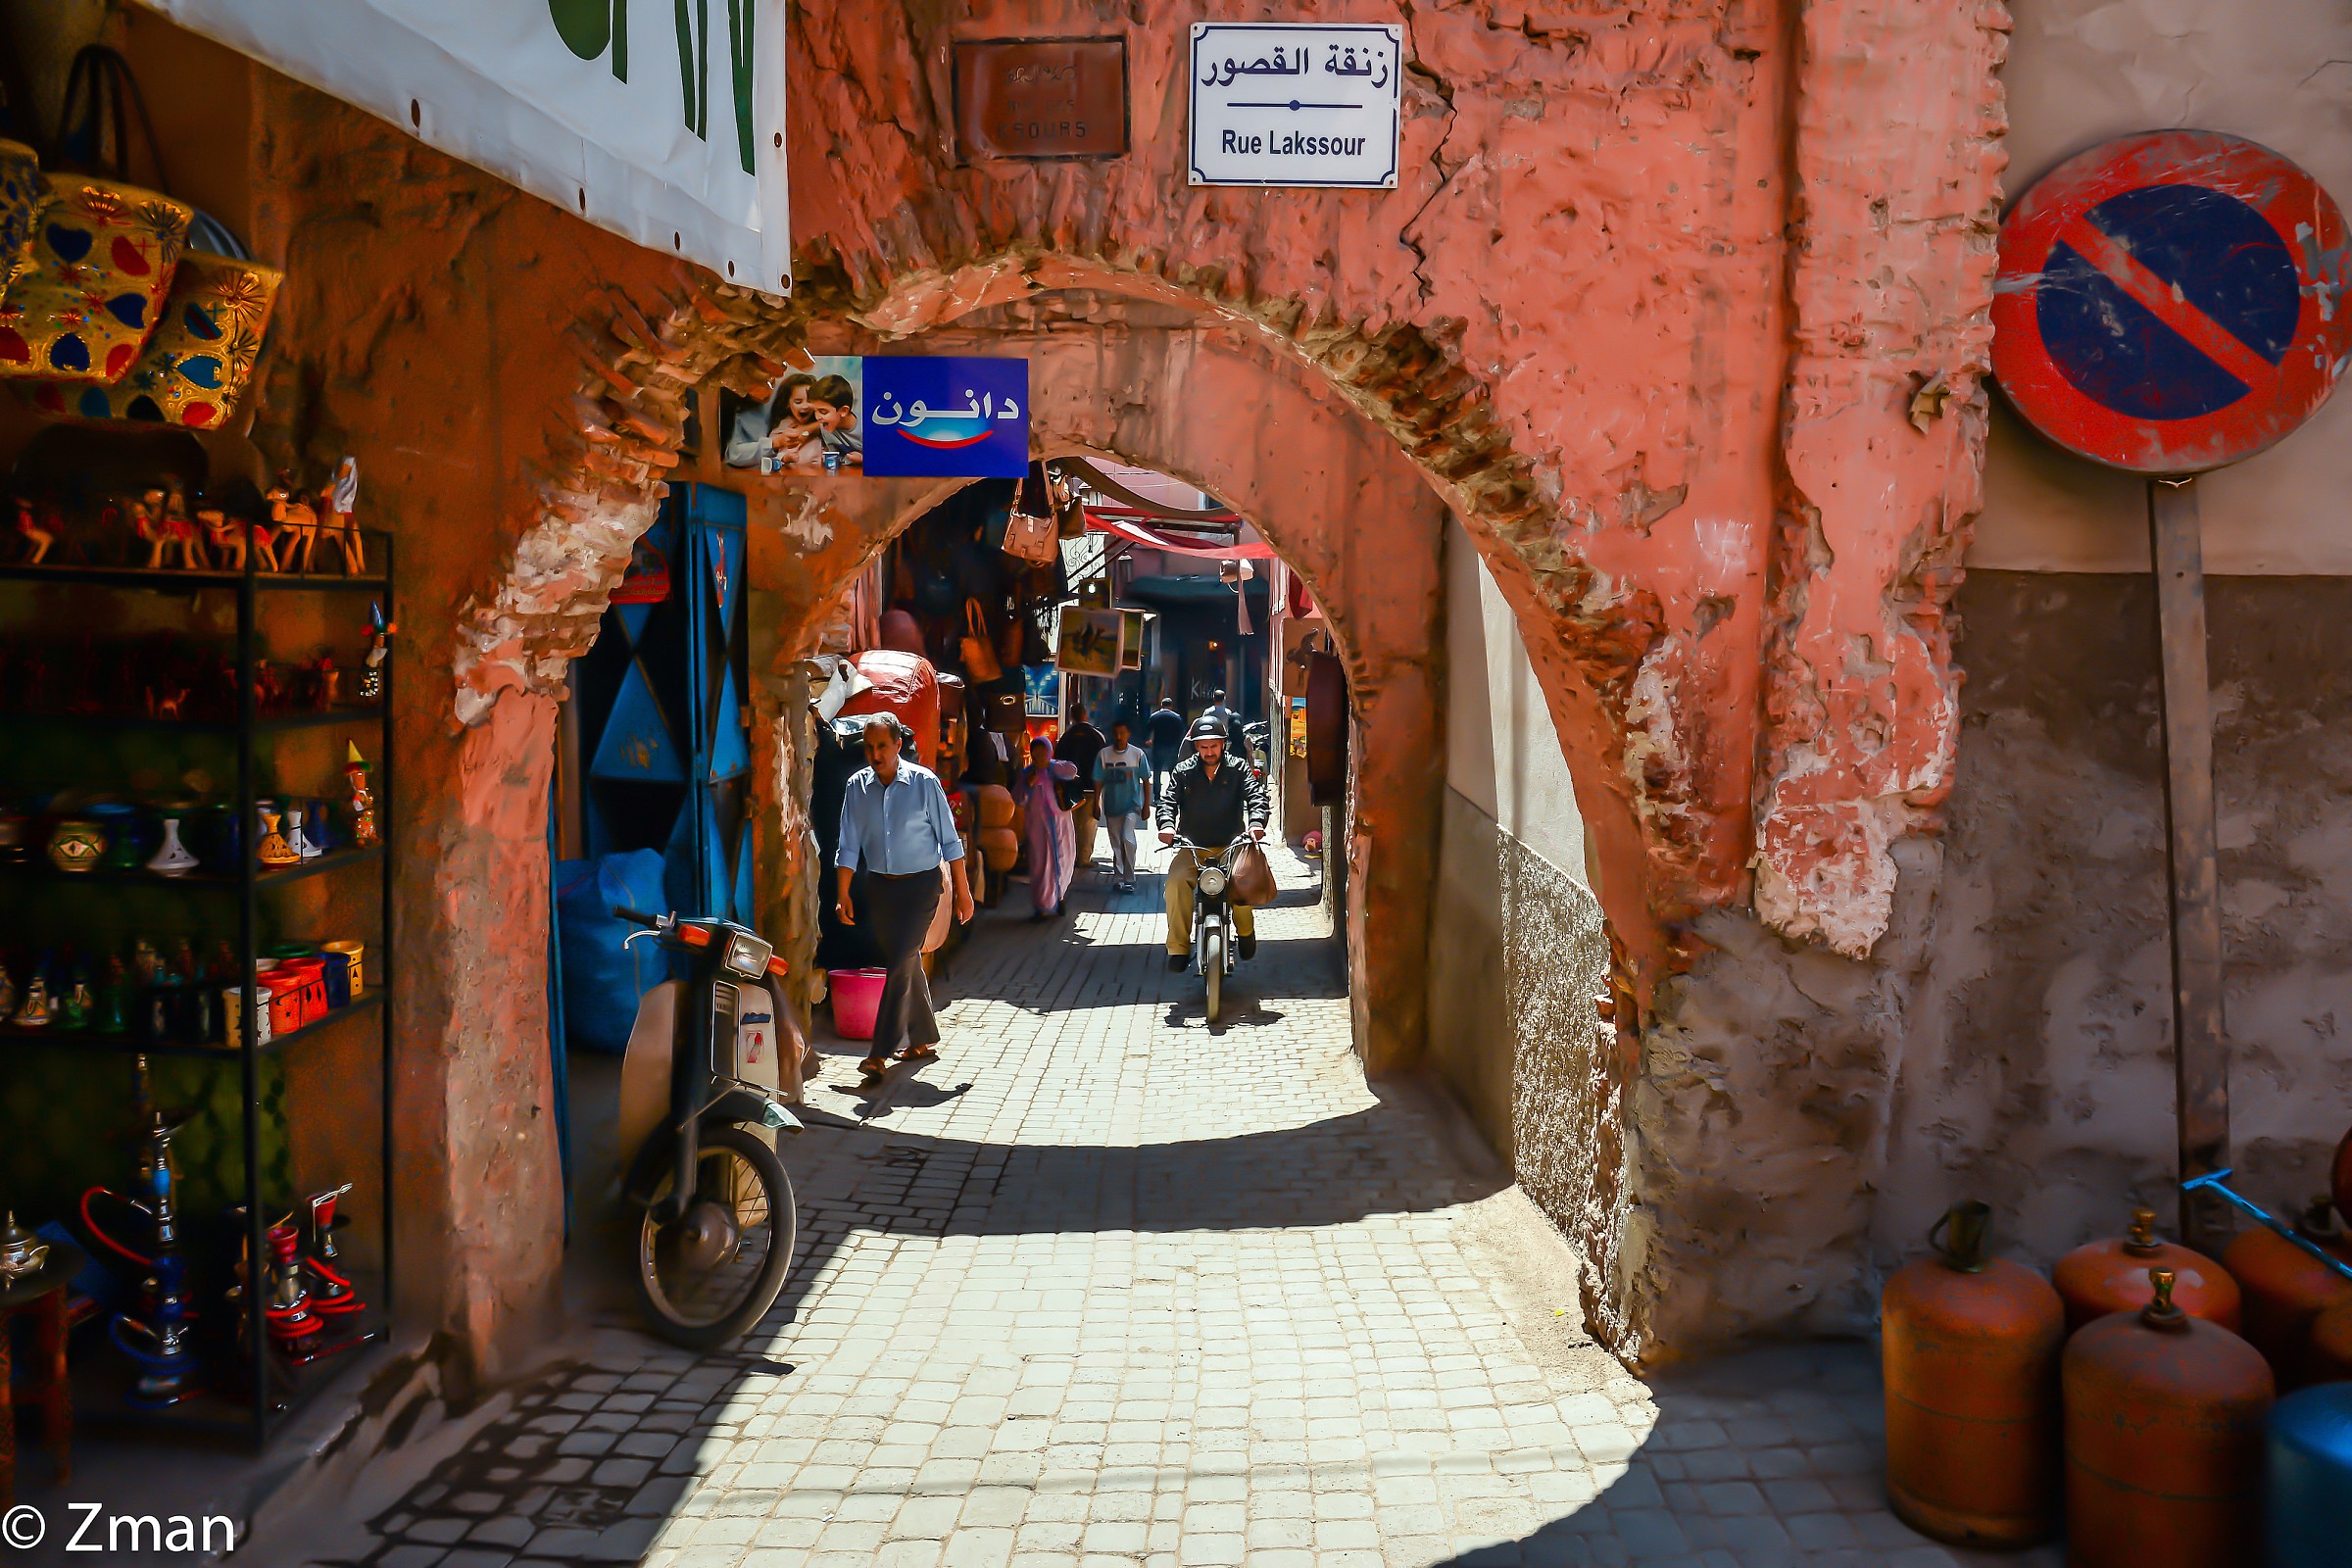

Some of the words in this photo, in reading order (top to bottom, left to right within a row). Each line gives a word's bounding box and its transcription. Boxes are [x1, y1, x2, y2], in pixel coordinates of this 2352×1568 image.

[1200, 45, 1309, 87] القصور
[1324, 44, 1389, 88] زنقة
[1222, 129, 1261, 155] Rue
[1269, 130, 1366, 157] Lakssour
[871, 389, 1019, 427] دانون
